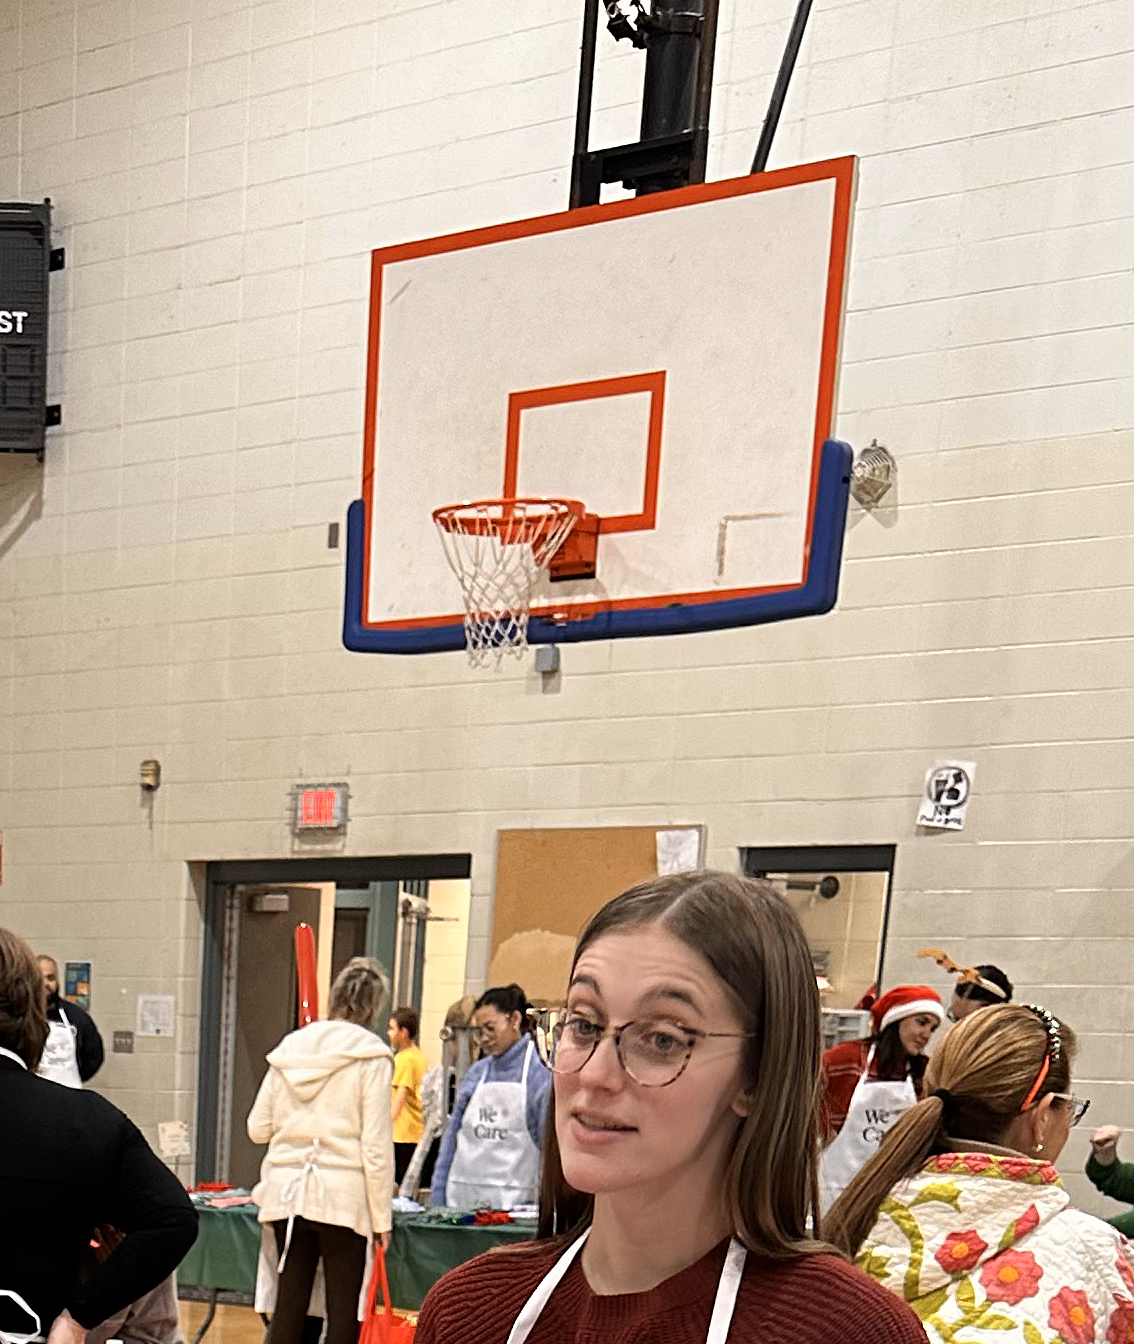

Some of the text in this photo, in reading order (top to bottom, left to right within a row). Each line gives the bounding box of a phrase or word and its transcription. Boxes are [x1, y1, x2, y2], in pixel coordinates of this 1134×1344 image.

[479, 1105, 498, 1123] We
[865, 1109, 890, 1124] We
[474, 1124, 508, 1140] Care
[863, 1127, 885, 1142] Ca
